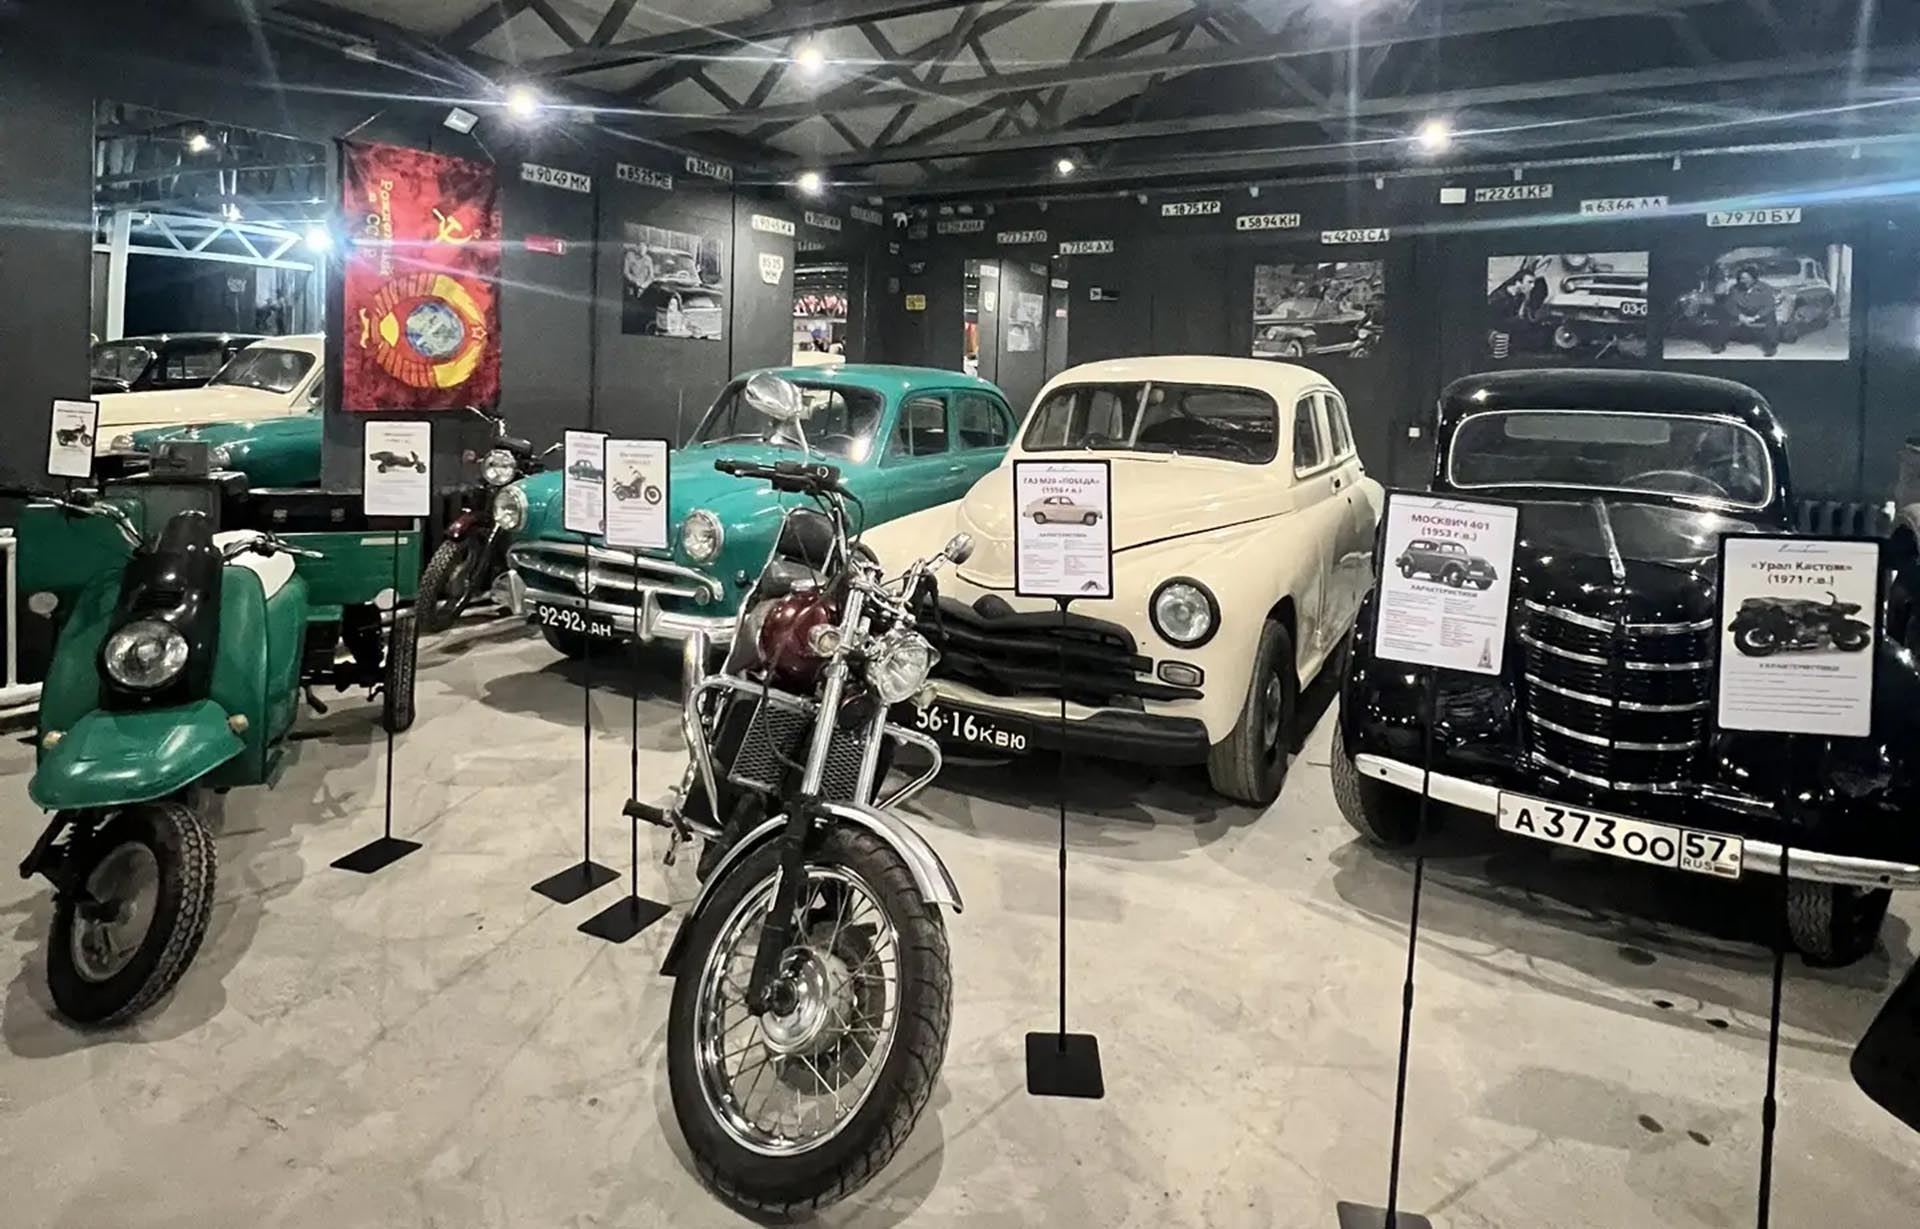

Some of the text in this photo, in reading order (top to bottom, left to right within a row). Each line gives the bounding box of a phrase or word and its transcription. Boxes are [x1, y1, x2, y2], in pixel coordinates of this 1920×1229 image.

[1410, 513, 1490, 531] МОСКВИЧ 401
[1767, 574, 1803, 585] (1971
[1686, 832, 1727, 862] 57
[1682, 857, 1714, 871] RUS
